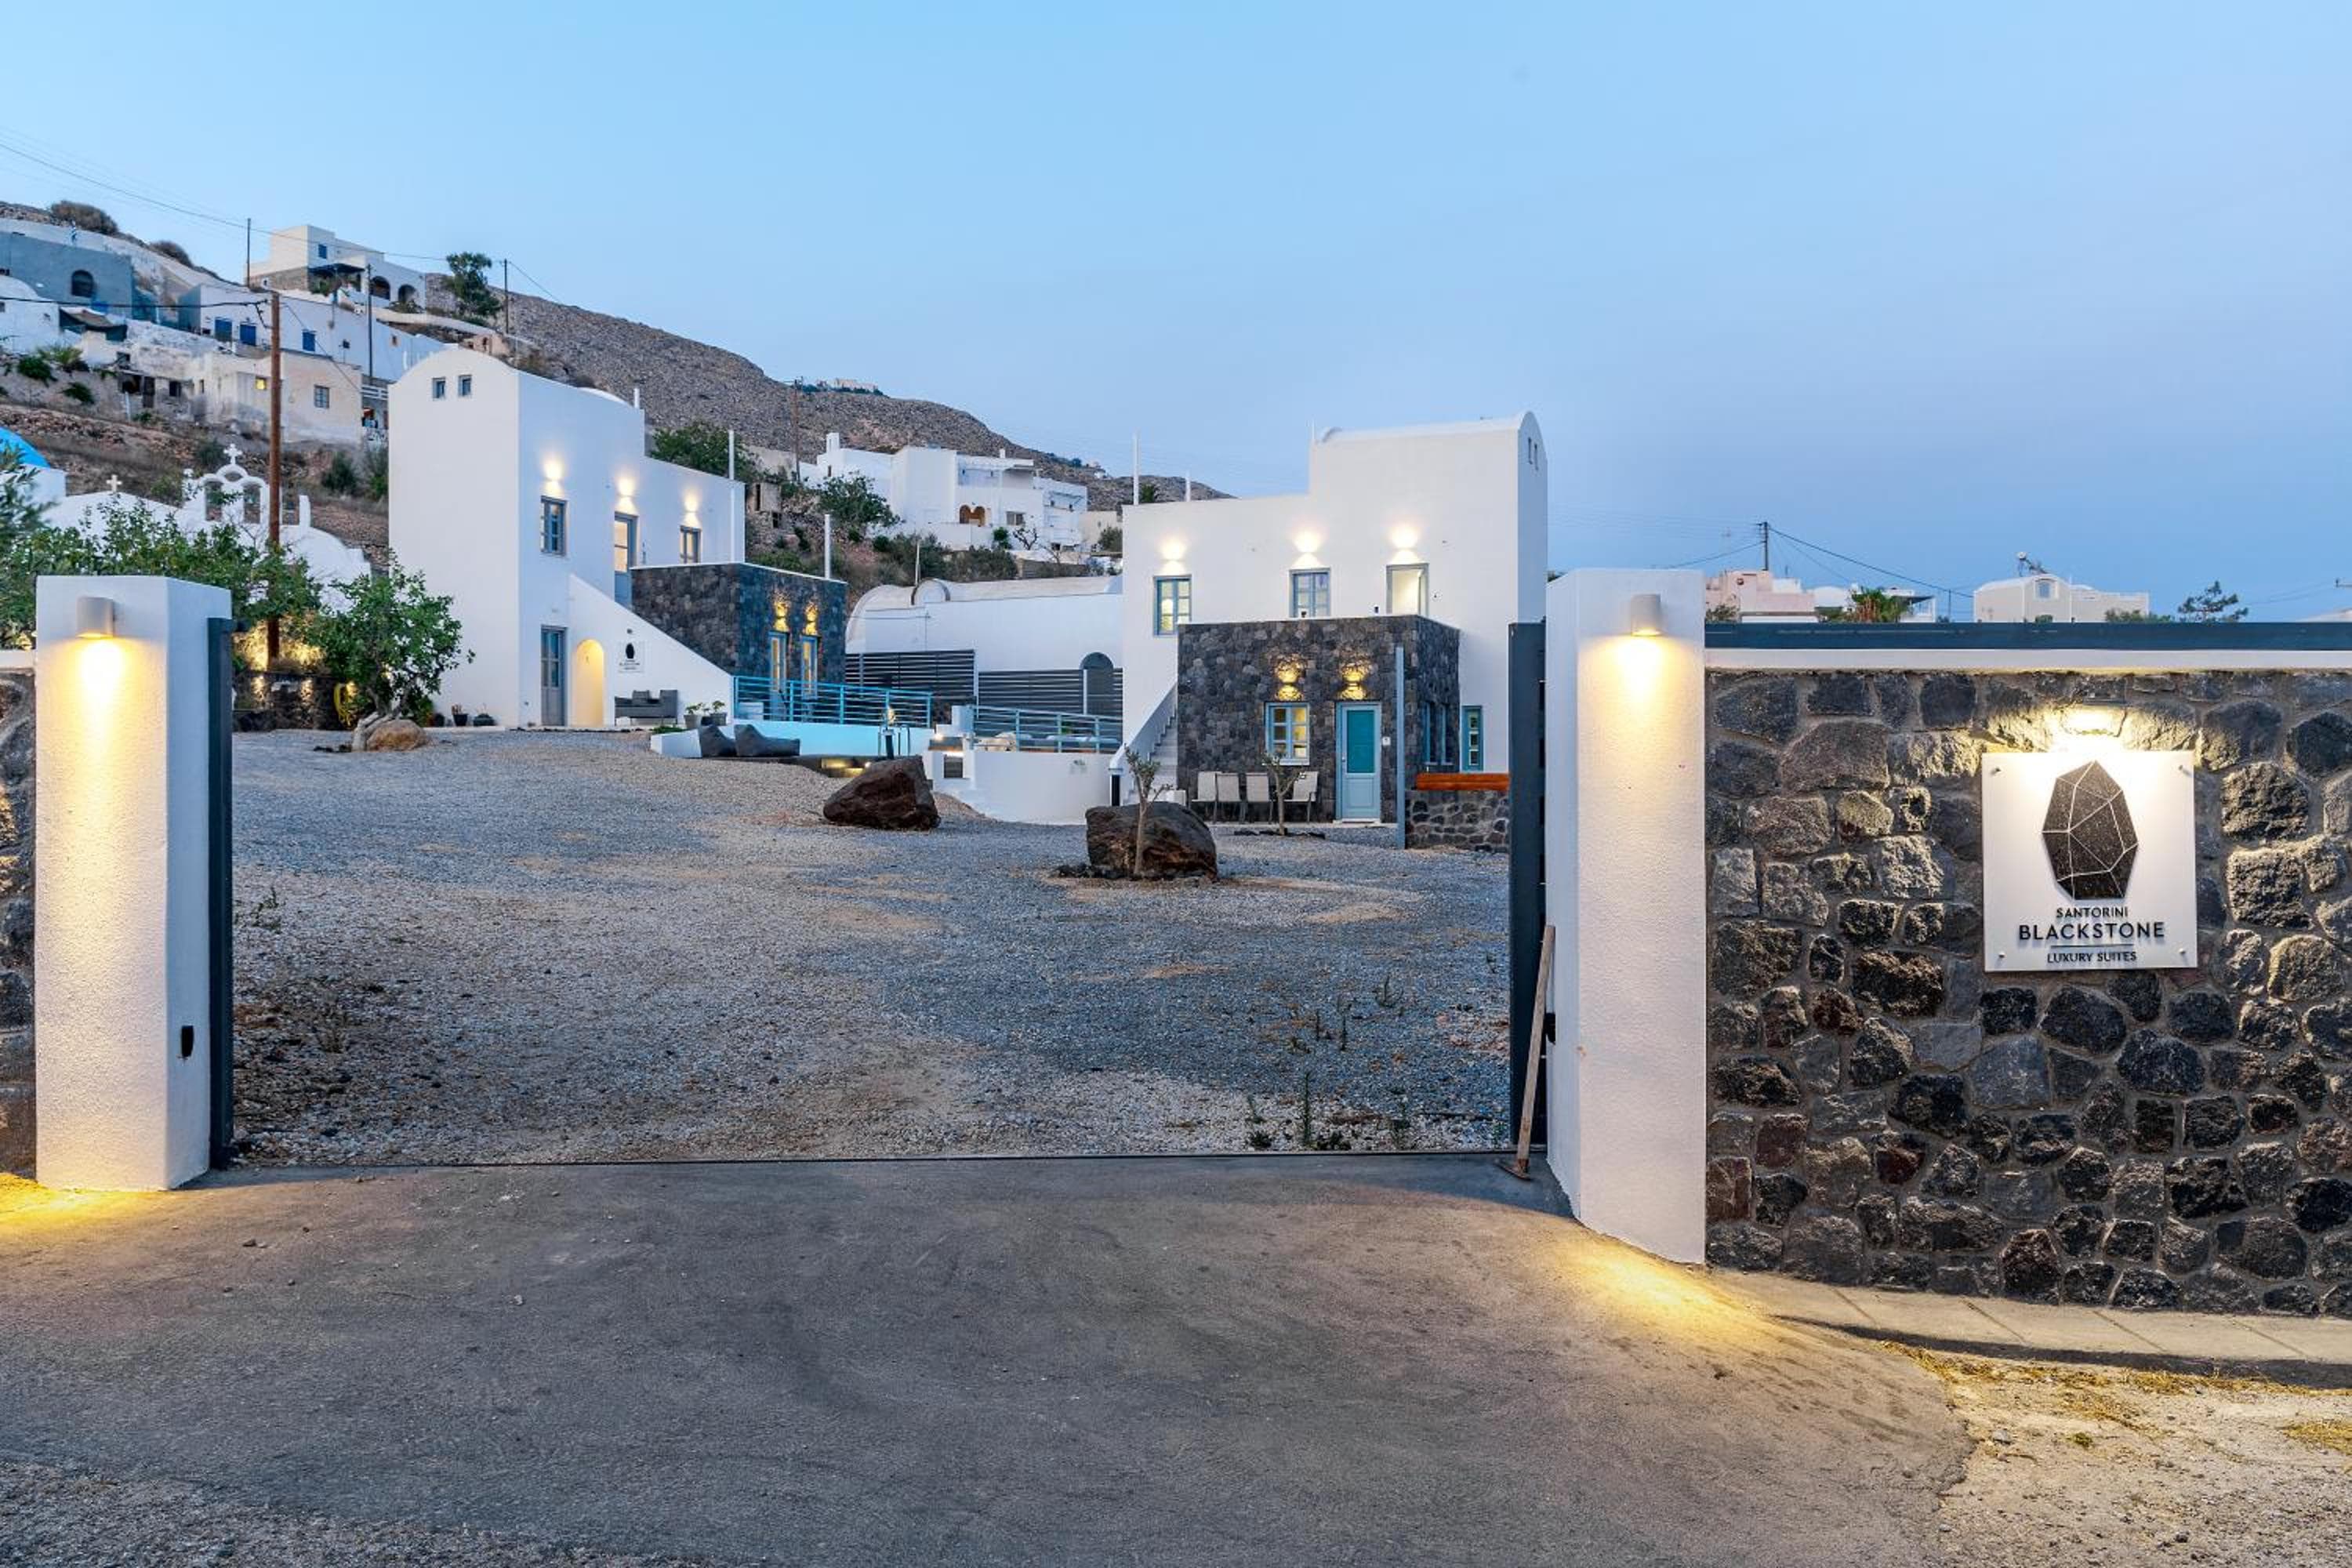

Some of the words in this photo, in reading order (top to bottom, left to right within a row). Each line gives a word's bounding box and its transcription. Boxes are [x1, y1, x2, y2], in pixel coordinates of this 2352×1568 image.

[2056, 906, 2129, 918] SANTORINI
[2019, 922, 2165, 940] BLACKSTONE
[2047, 953, 2092, 964] LUXURY
[2097, 951, 2137, 962] SUITES
